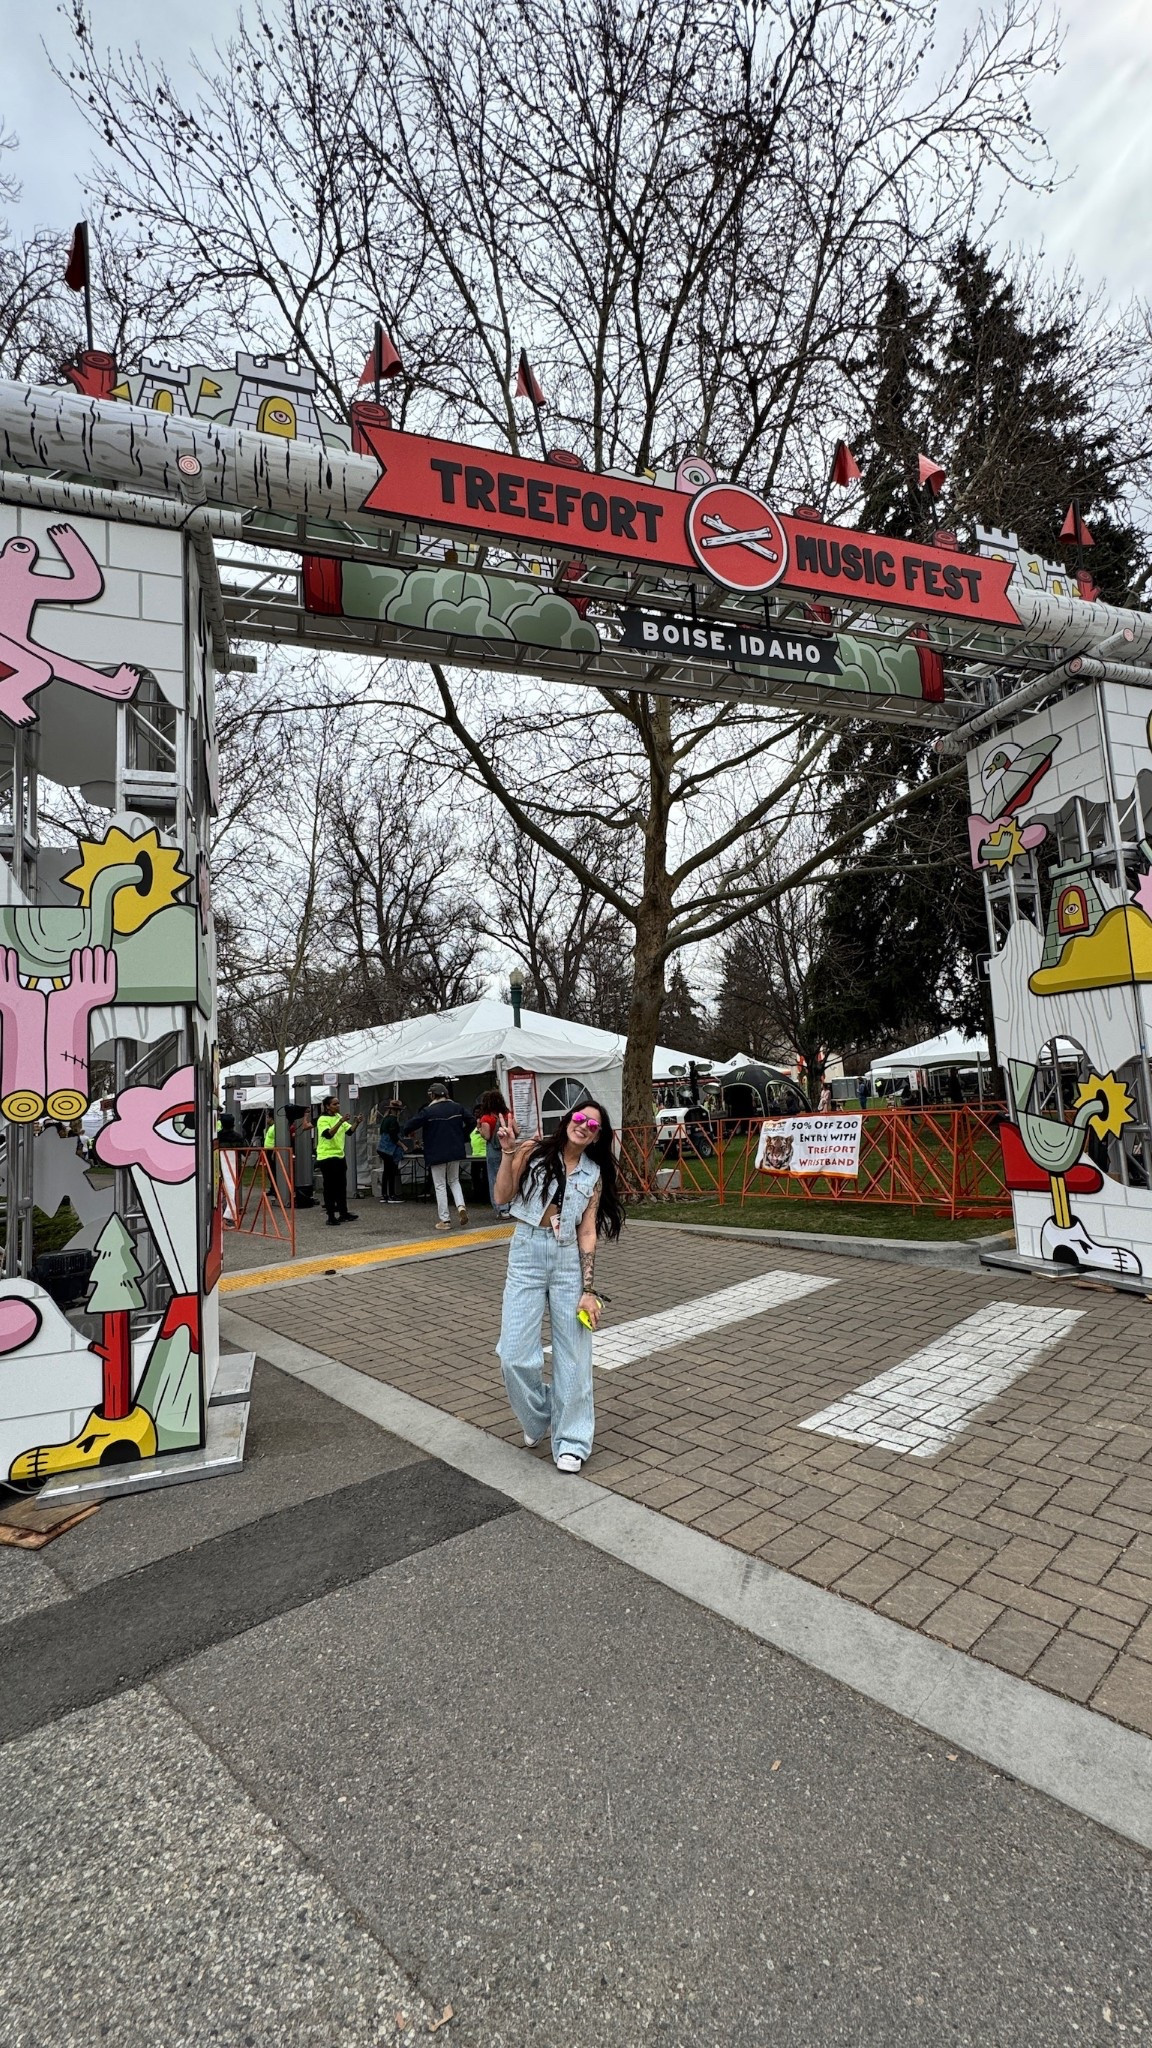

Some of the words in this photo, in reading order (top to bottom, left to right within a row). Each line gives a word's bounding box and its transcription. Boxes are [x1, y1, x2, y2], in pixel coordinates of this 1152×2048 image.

[430, 458, 664, 543] TREEFORT
[796, 535, 897, 587] MUSIC
[902, 555, 982, 603] FEST
[739, 635, 821, 664] IDAHO
[791, 1121, 812, 1130] 50%
[814, 1121, 834, 1130] OFF
[836, 1120, 858, 1129] ZOO
[800, 1133, 828, 1142] ENTRY
[830, 1133, 856, 1142] WITH
[807, 1145, 855, 1154] TREEFORT
[799, 1158, 855, 1167] WRISTBAND
